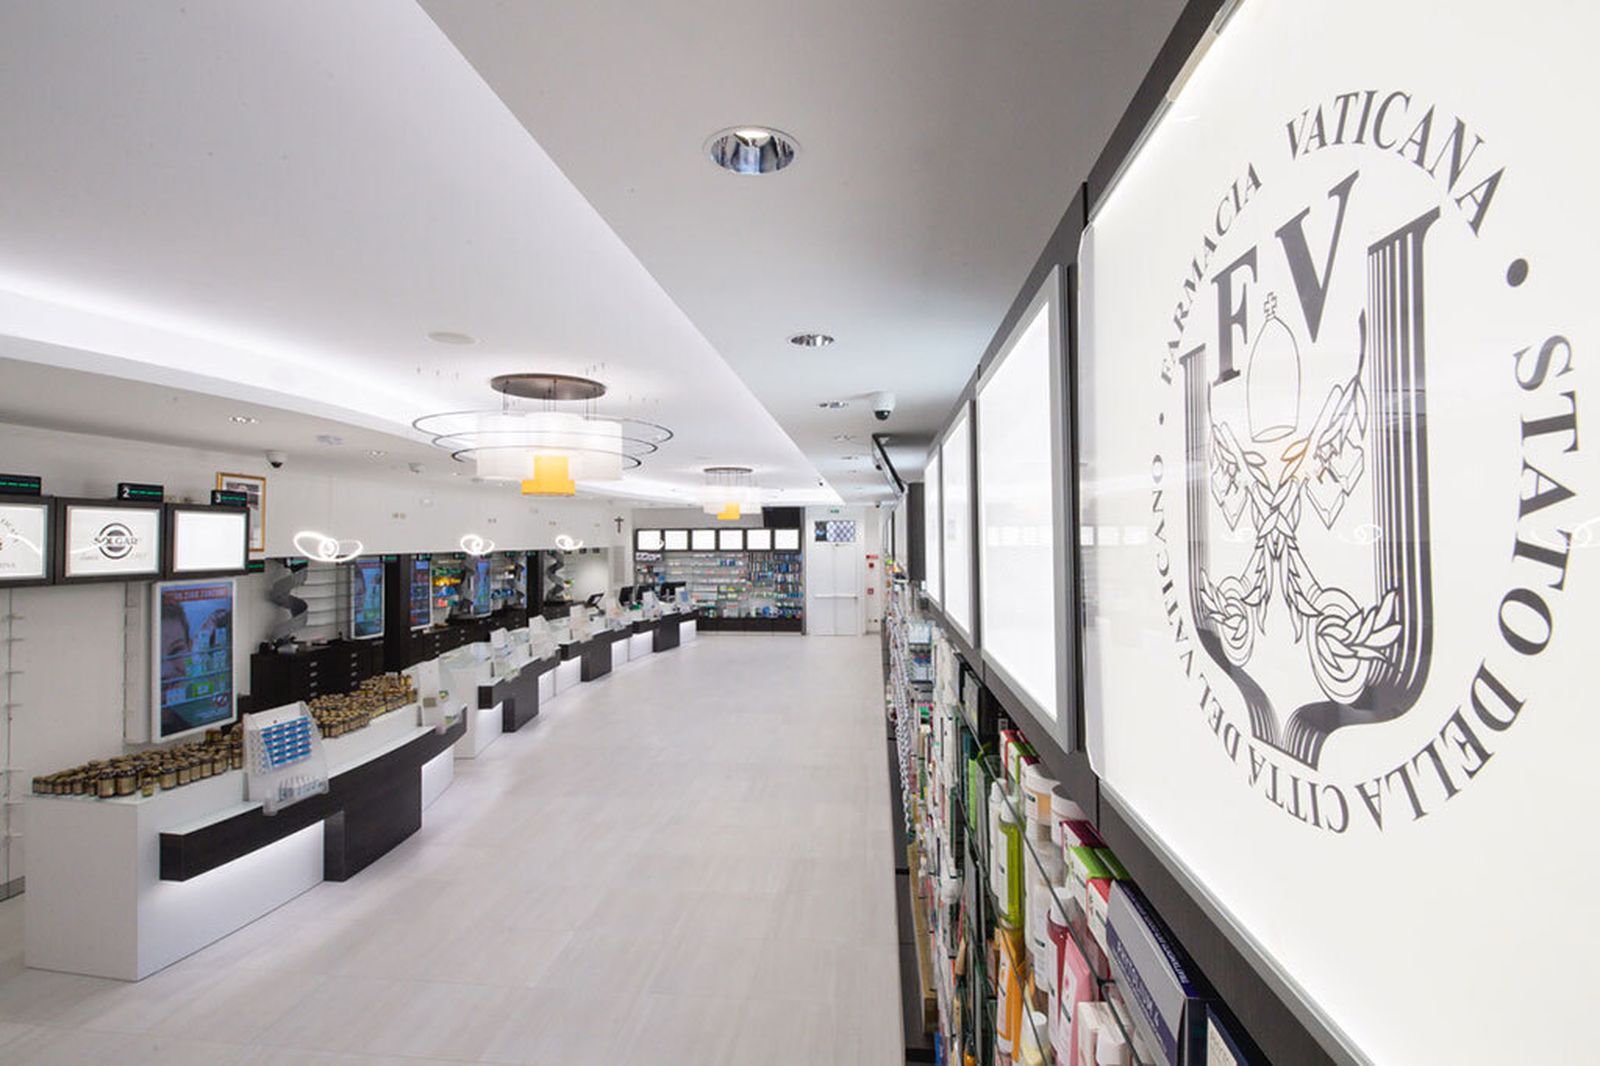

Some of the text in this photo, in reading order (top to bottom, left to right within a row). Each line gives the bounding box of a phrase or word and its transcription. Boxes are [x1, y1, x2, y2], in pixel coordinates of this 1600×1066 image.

[1160, 90, 1506, 386] FARMACIA VATICANA
[122, 487, 130, 498] 2
[1152, 454, 1194, 679] VATICANO
[1498, 334, 1580, 656] STATO
[1199, 672, 1241, 764] DEL
[1355, 658, 1528, 832] DELLA
